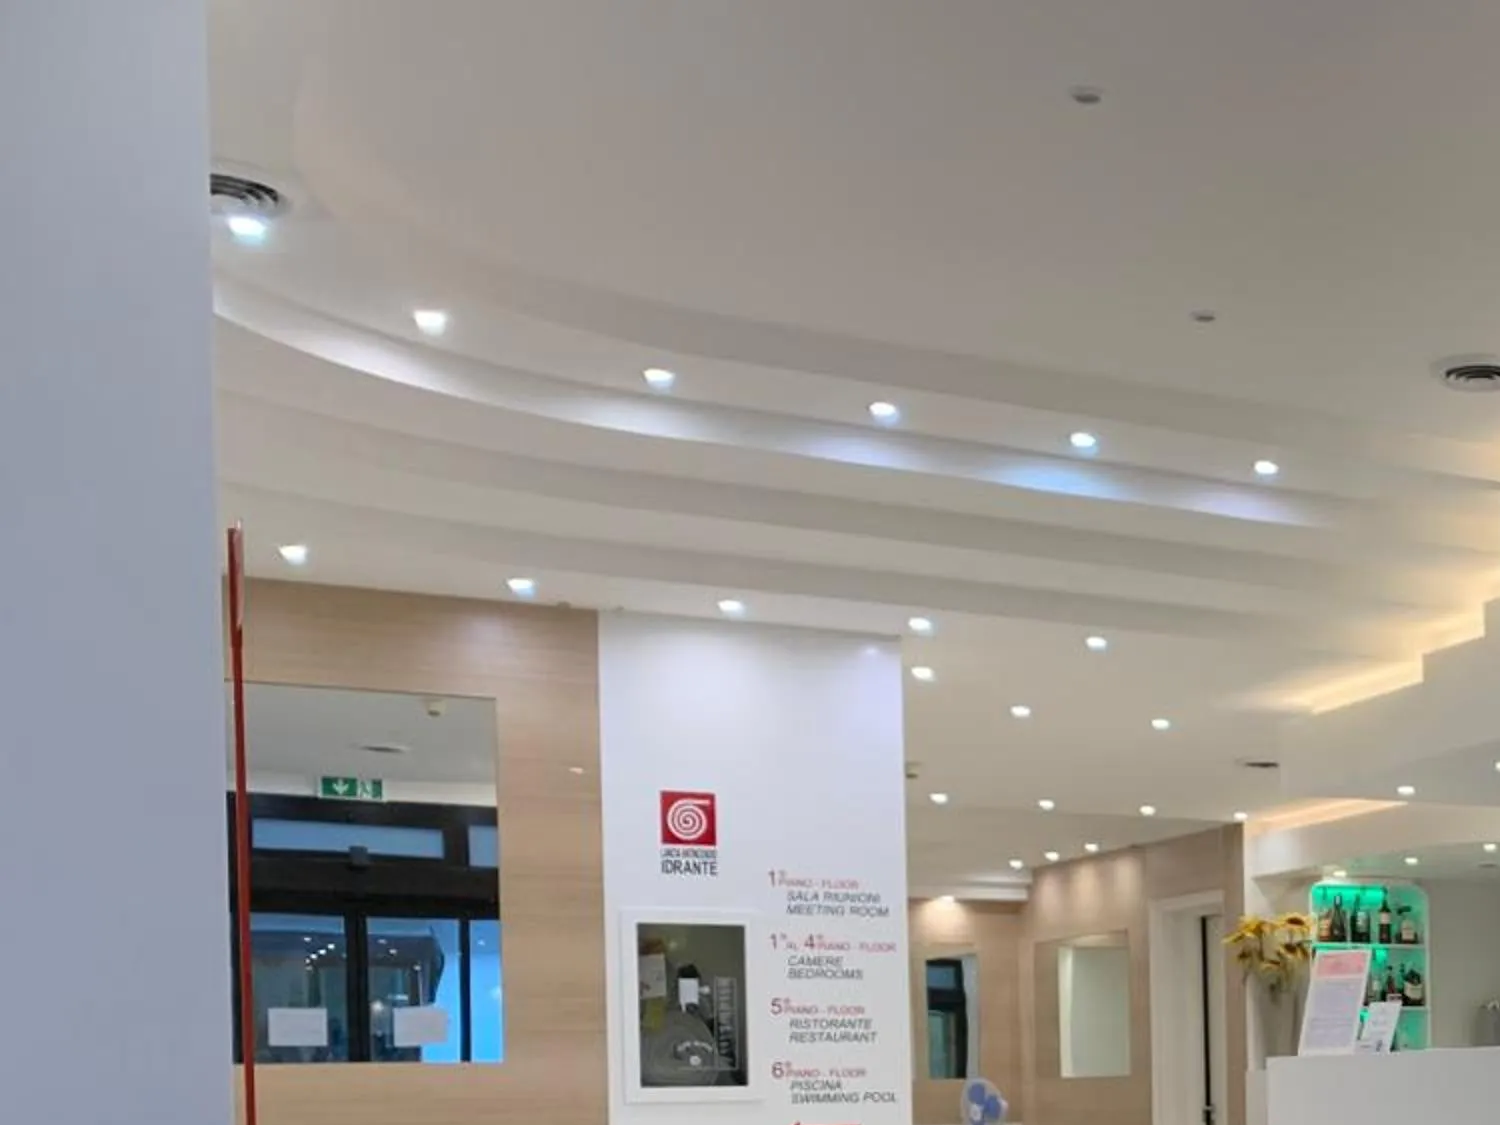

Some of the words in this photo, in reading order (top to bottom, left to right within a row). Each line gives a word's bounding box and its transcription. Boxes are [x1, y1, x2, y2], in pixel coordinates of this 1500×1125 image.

[660, 859, 718, 875] IDRANTE
[787, 891, 819, 902] SALA
[786, 903, 845, 916] MEETING
[850, 905, 889, 917] ROOM
[787, 955, 844, 967] CAMERE
[787, 968, 863, 980] BEDROOMS
[789, 1018, 872, 1030] RISTORANTE
[789, 1031, 877, 1043] RESTAURANT
[790, 1080, 842, 1091] PISCINA
[791, 1092, 860, 1104] SWIMMING
[863, 1091, 896, 1103] POOL
